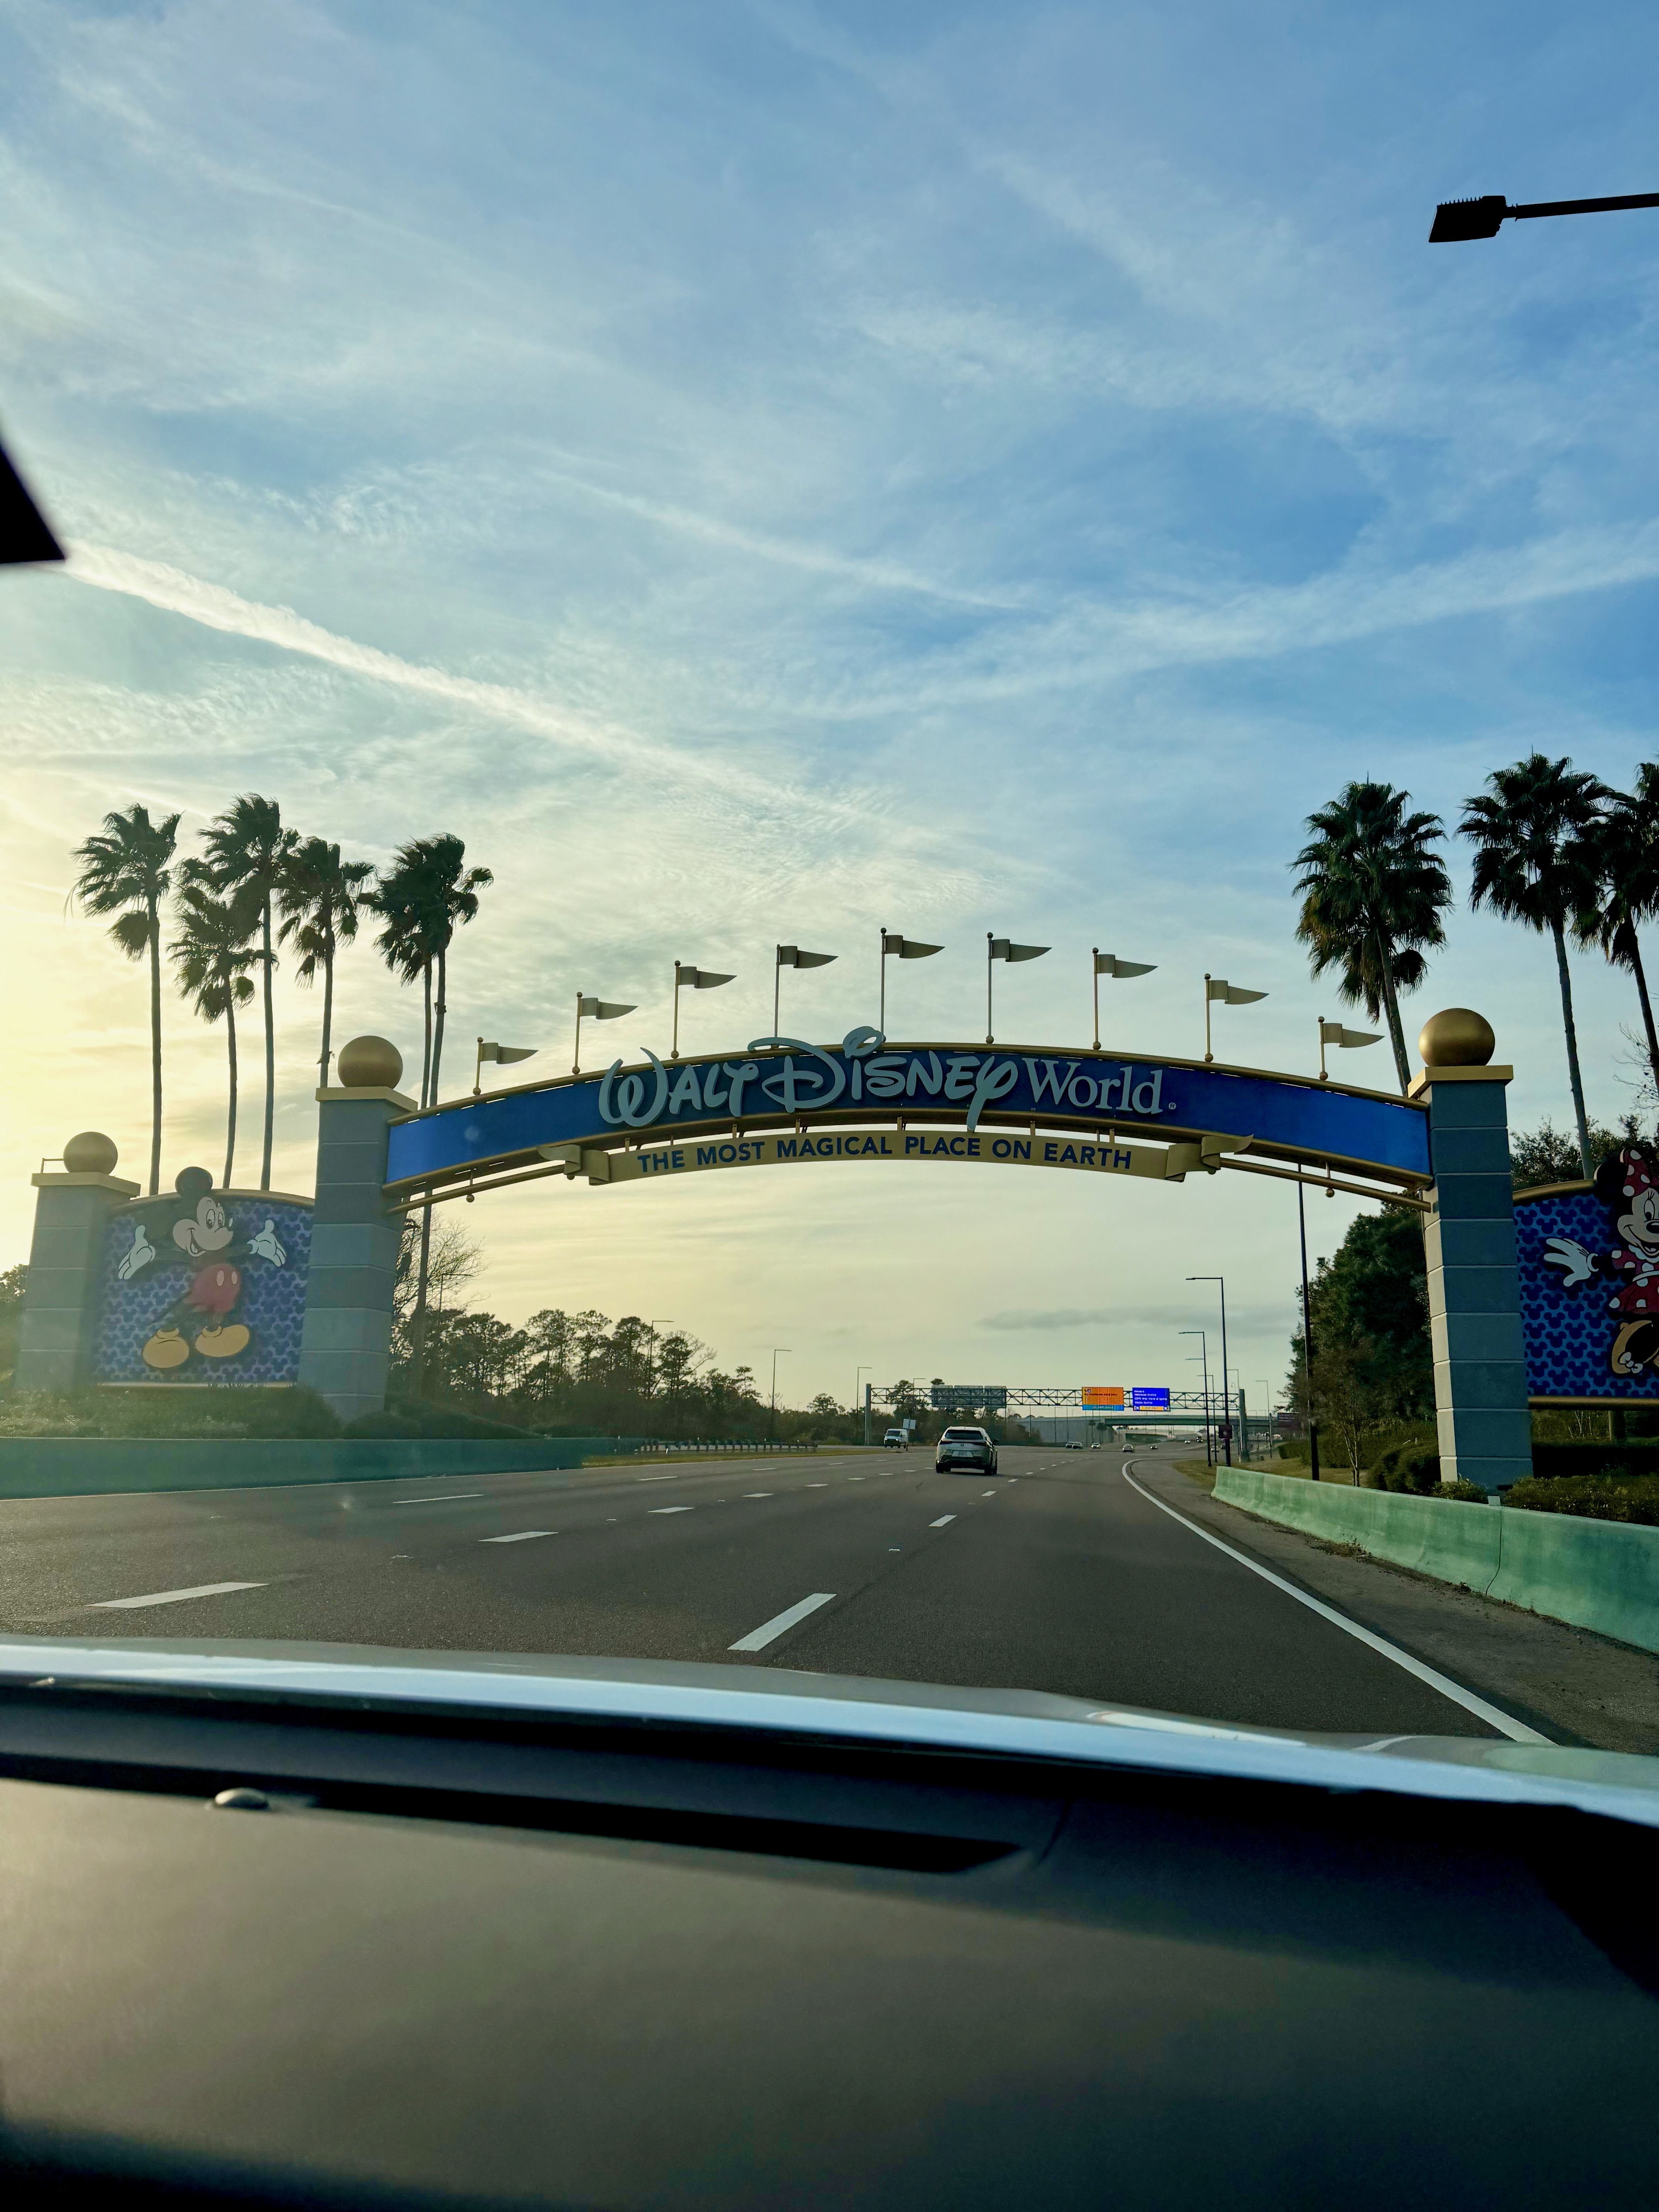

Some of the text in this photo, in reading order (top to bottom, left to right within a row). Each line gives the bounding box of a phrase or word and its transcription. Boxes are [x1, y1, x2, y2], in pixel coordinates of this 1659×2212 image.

[637, 1136, 1132, 1173] THE MOST MAGICAL PLACE ON EARTH
